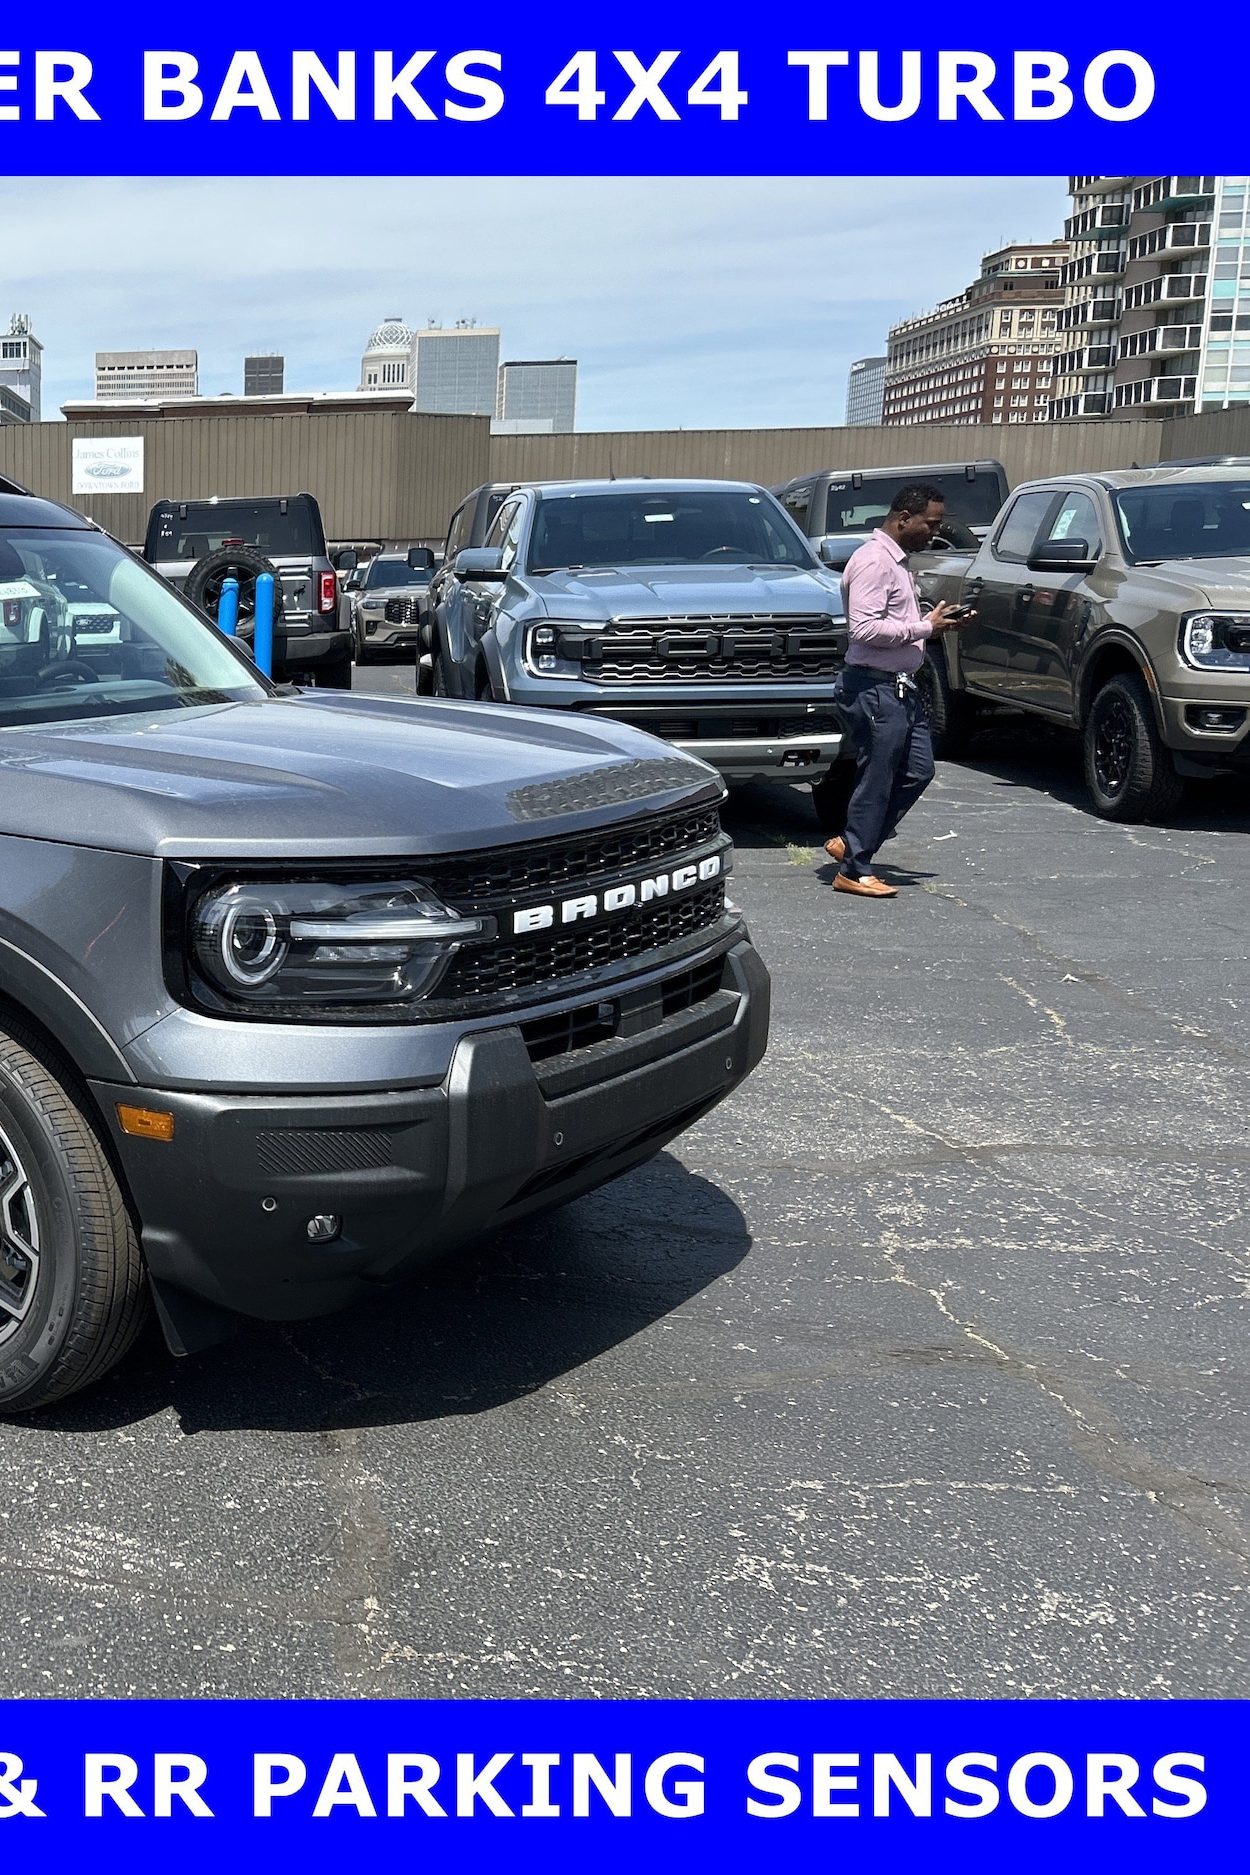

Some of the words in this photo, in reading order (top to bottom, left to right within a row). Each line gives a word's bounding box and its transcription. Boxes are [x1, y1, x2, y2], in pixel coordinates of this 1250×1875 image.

[75, 449, 104, 459] James
[106, 447, 140, 458] Collins
[92, 464, 122, 475] Ford
[76, 482, 119, 490] DOWNTOWN
[121, 481, 140, 489] FORD
[513, 856, 721, 935] BRONCO
